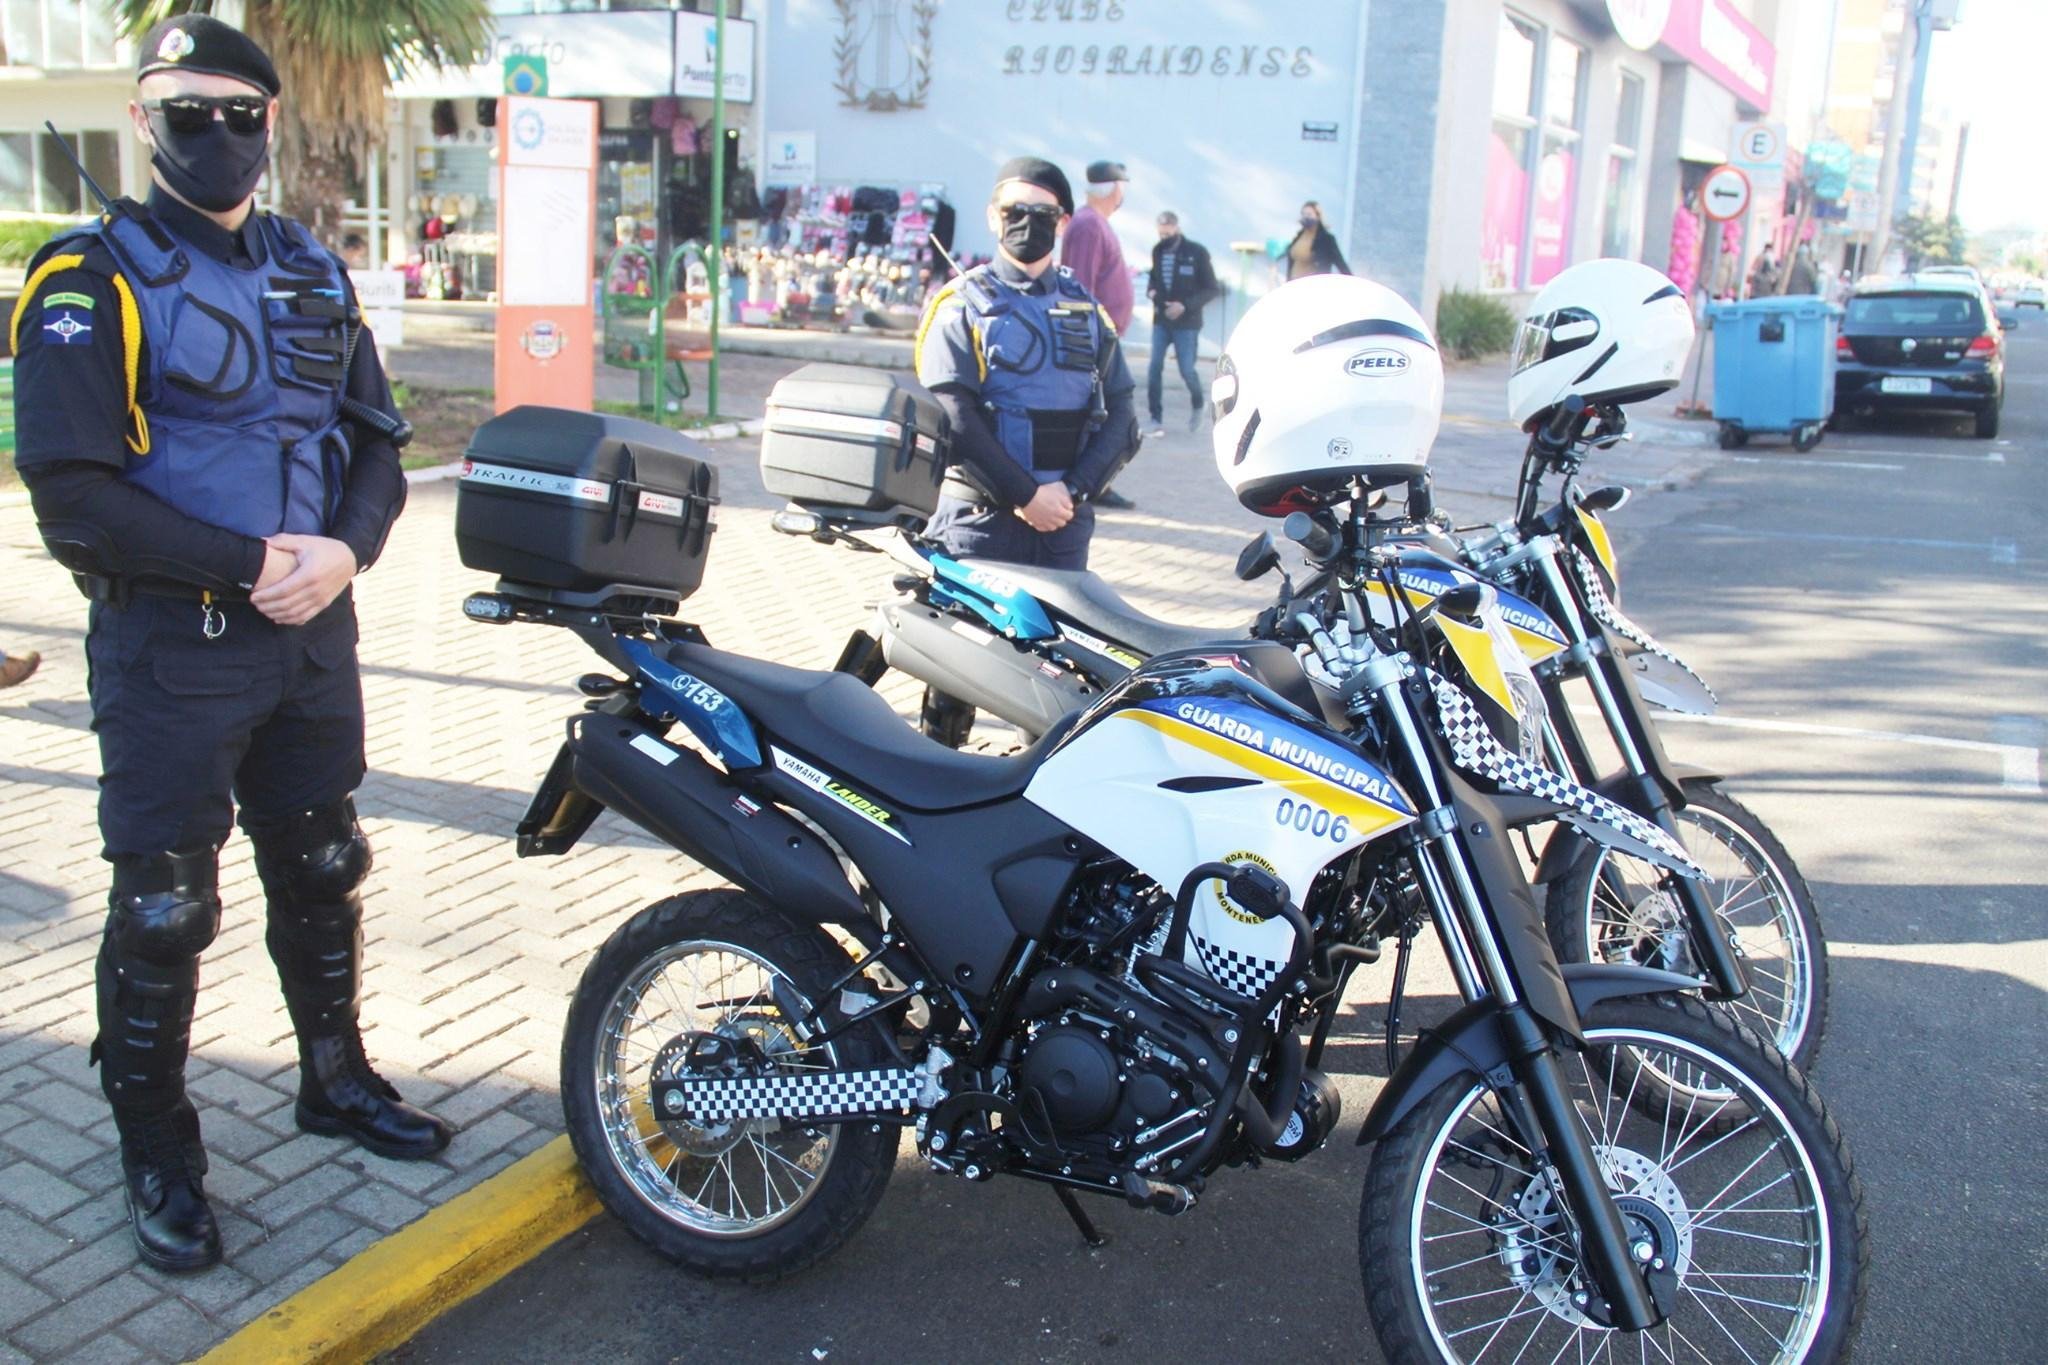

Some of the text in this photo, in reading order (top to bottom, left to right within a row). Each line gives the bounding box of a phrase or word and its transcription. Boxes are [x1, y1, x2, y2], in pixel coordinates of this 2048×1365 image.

[1751, 133, 1767, 154] E
[1351, 358, 1407, 369] PEELS
[1497, 604, 1556, 638] NICIPAL
[684, 683, 724, 712] 153
[1177, 702, 1394, 804] GUARDA MUNICIPAL
[783, 757, 891, 823] YAMAHA LANDER
[1276, 797, 1350, 843] 0006
